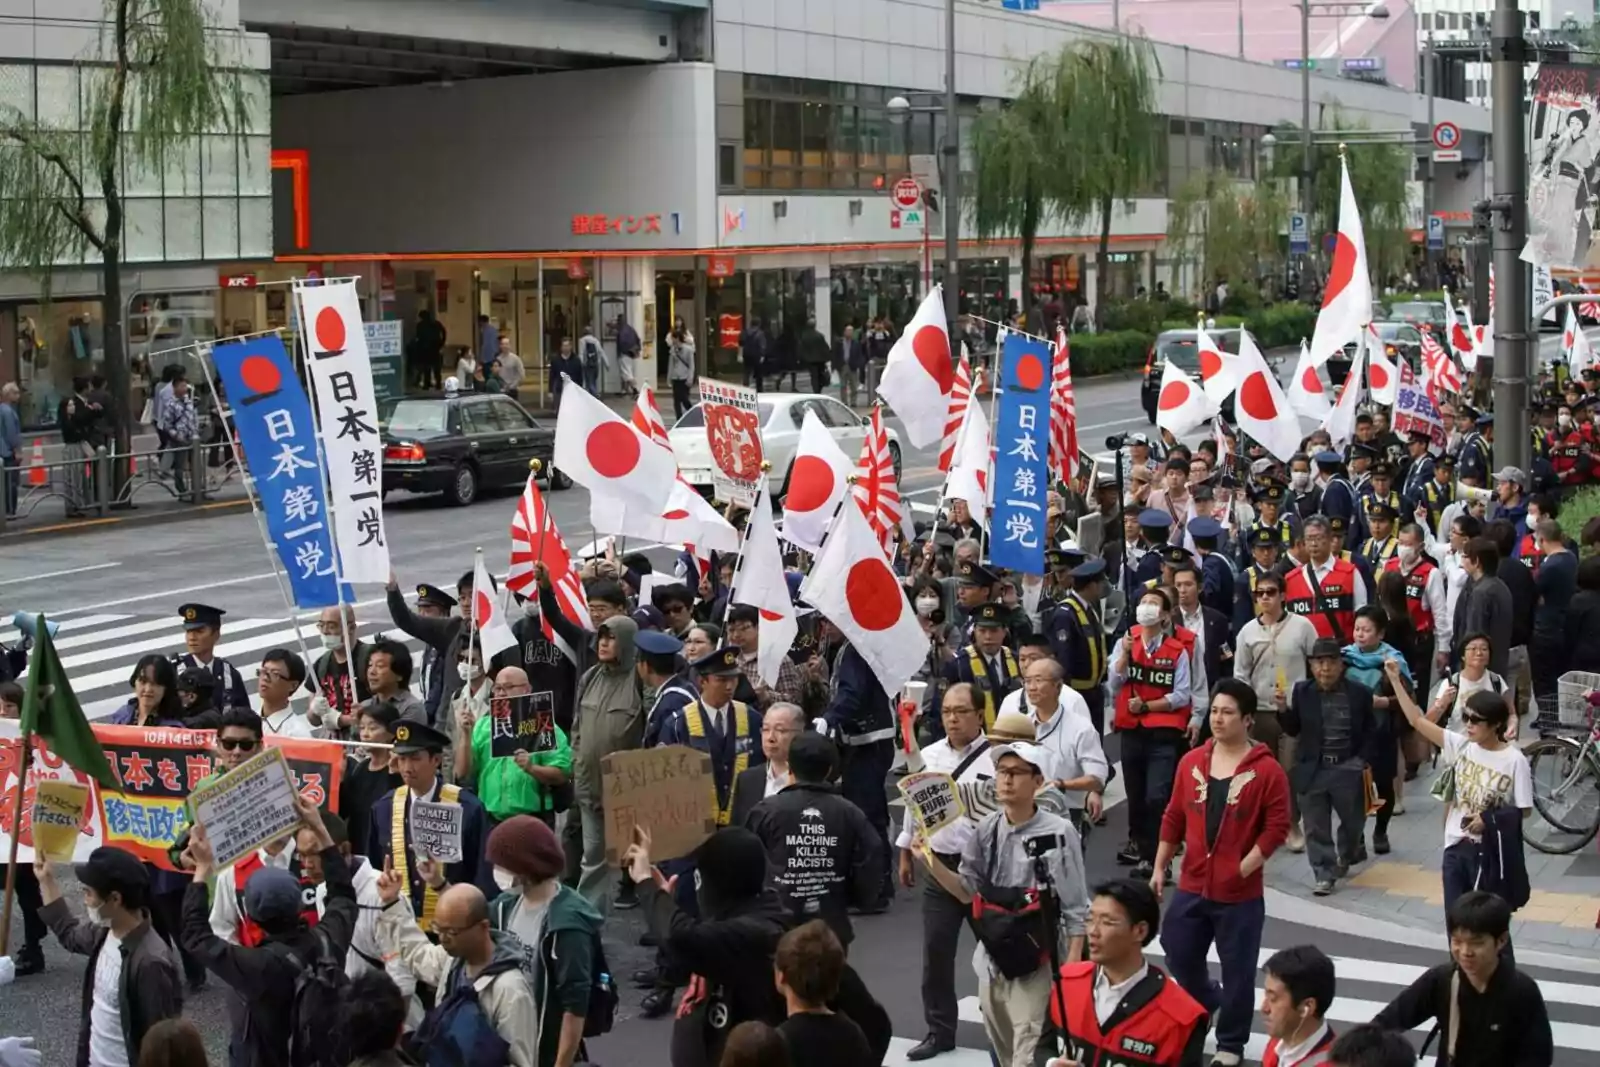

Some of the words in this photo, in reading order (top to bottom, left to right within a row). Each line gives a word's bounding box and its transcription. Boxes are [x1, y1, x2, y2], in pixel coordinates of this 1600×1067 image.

[571, 214, 661, 236] 銀座インズ
[671, 212, 681, 235] 1
[1292, 216, 1304, 231] P
[1430, 217, 1440, 231] P
[227, 276, 249, 287] KFC
[329, 371, 384, 548] 日本第一党
[1004, 405, 1041, 549] 日本第一党
[263, 409, 335, 580] 日本第一党
[1293, 598, 1340, 613] POLCE
[524, 640, 562, 666] GAP
[1127, 666, 1173, 685] OLICE
[417, 806, 427, 816] NO
[799, 823, 826, 835] THIS
[785, 835, 839, 847] MACHINE
[796, 846, 828, 857] KILLS
[787, 857, 835, 868] RACISTS
